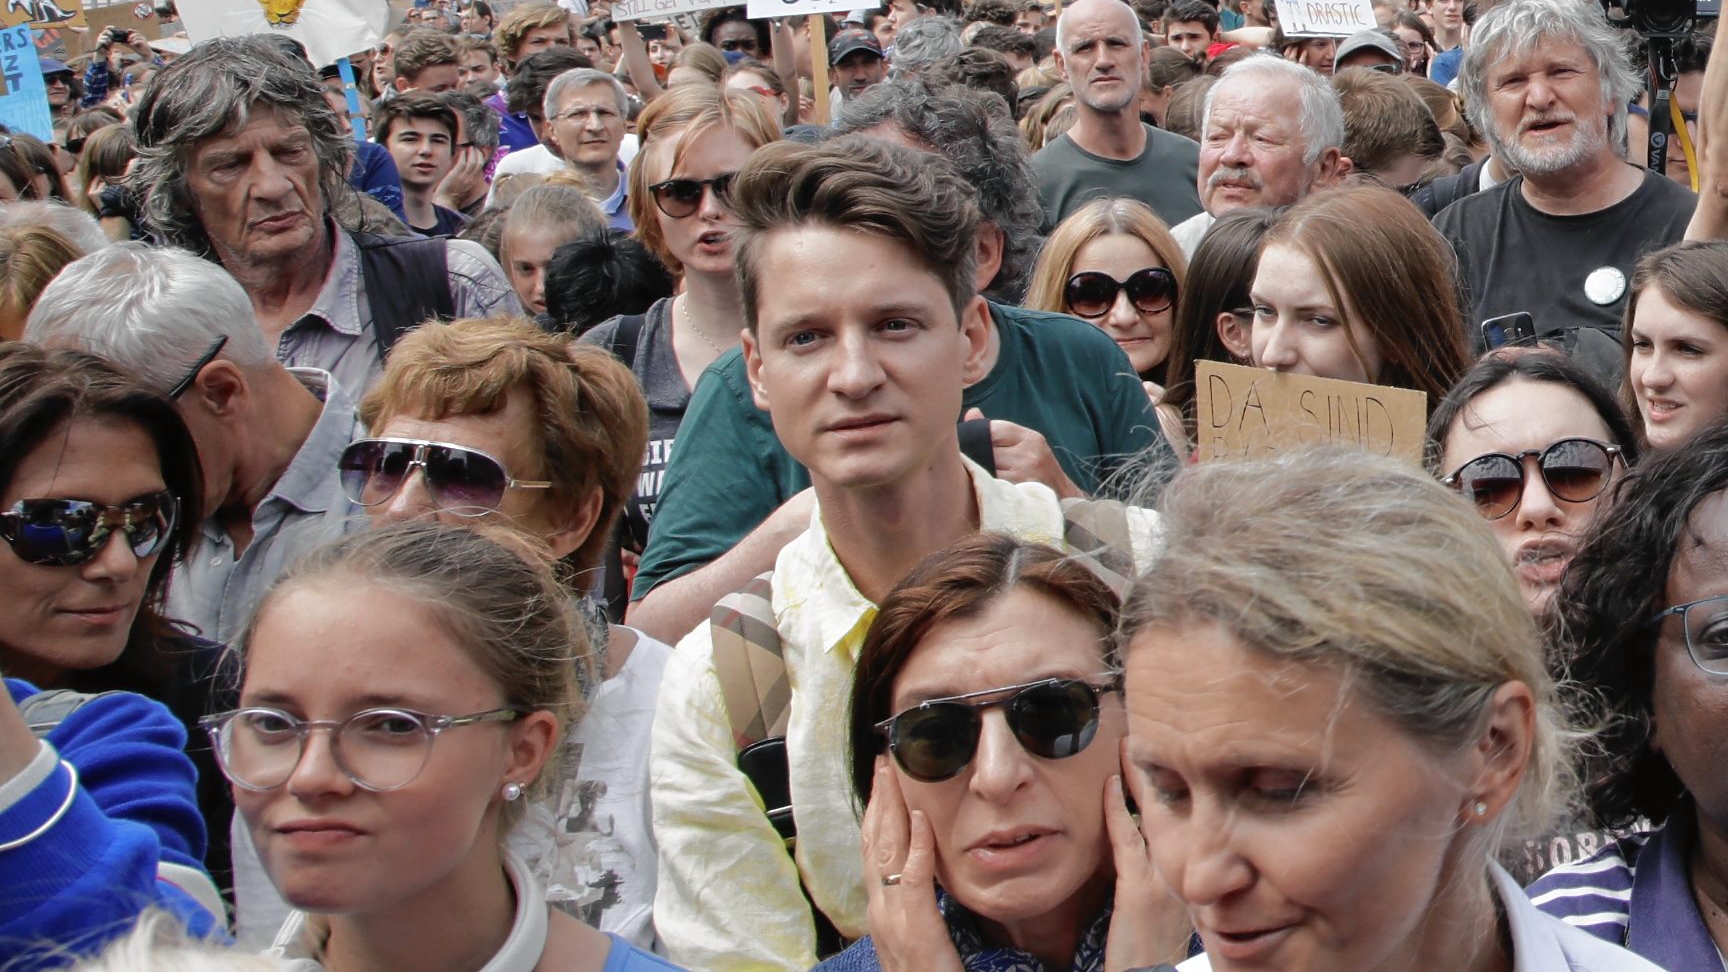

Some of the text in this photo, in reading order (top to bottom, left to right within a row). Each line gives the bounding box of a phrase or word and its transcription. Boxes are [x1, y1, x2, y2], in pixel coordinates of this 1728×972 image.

[615, 0, 651, 17] STILL
[1306, 2, 1368, 25] DRASTIC
[1209, 374, 1394, 459] DA SIND
